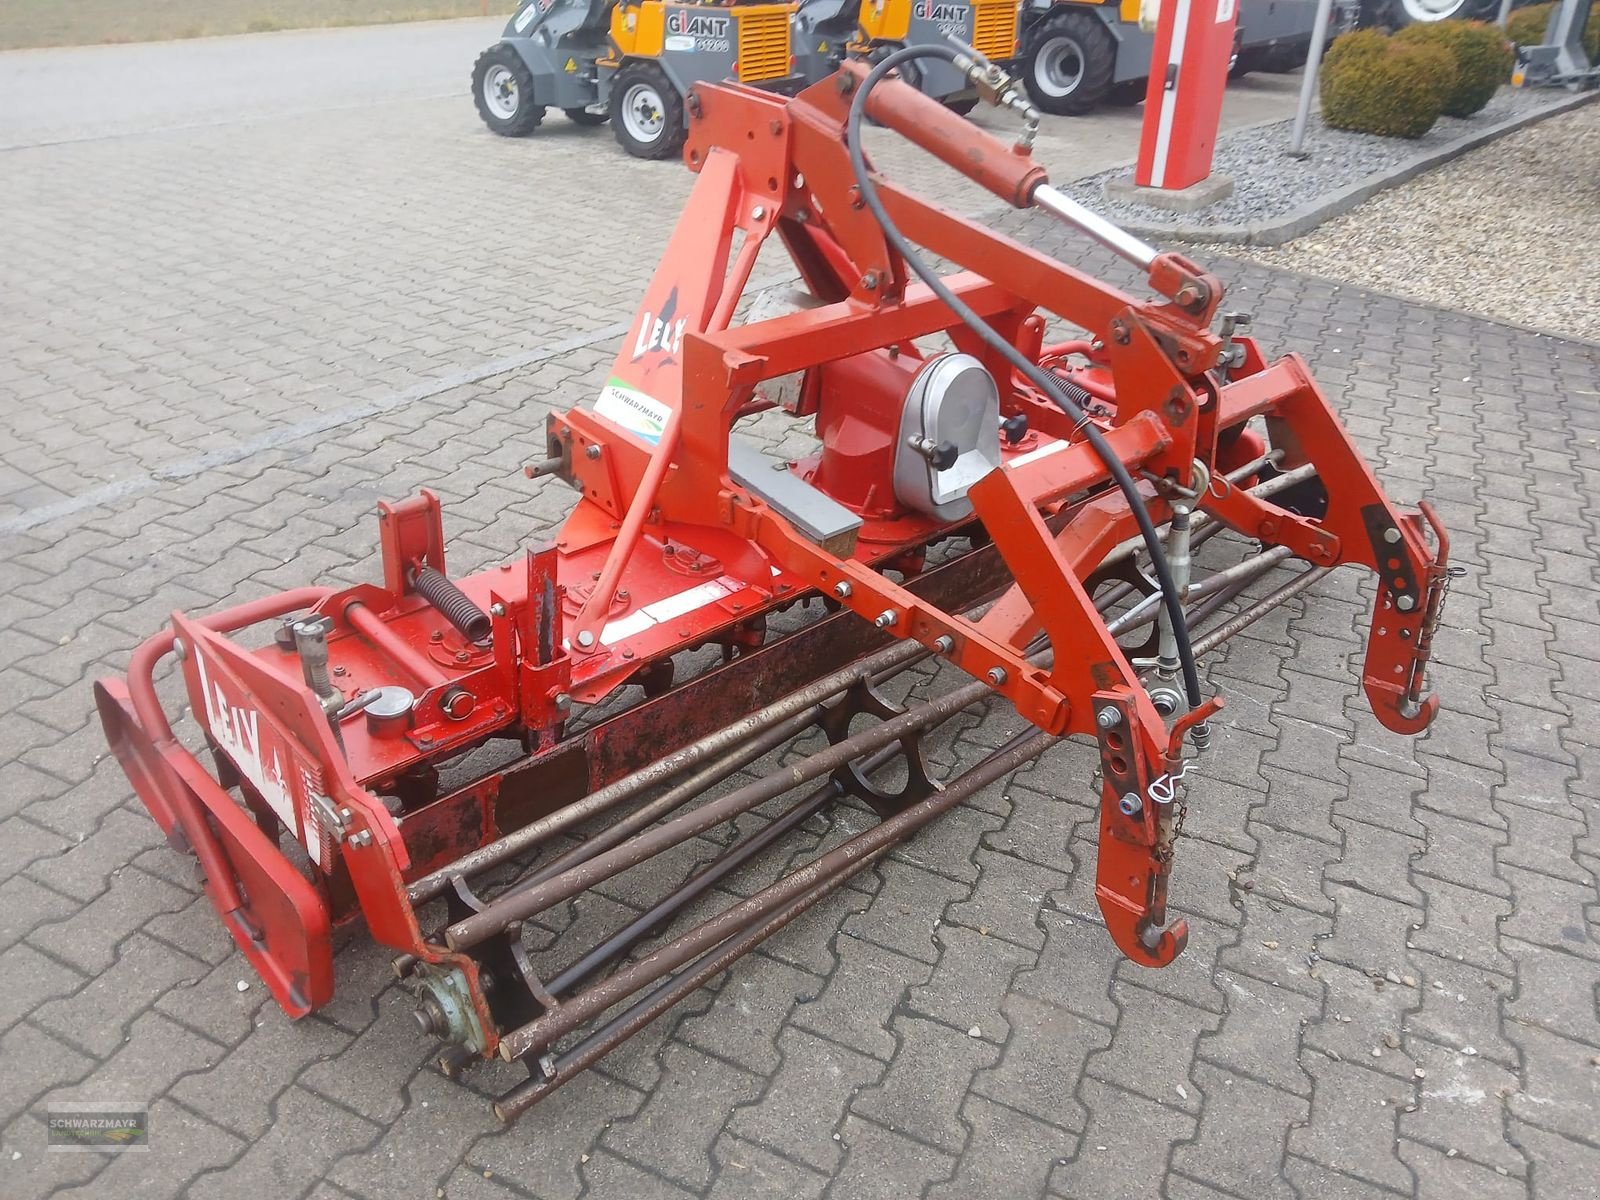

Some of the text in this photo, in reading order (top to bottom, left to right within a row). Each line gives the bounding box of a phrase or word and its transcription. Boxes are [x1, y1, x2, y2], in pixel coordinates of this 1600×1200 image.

[667, 10, 730, 38] GIANT
[913, 0, 970, 23] GIANT
[632, 311, 690, 358] LELY
[611, 388, 663, 423] SCHWARZMAYR
